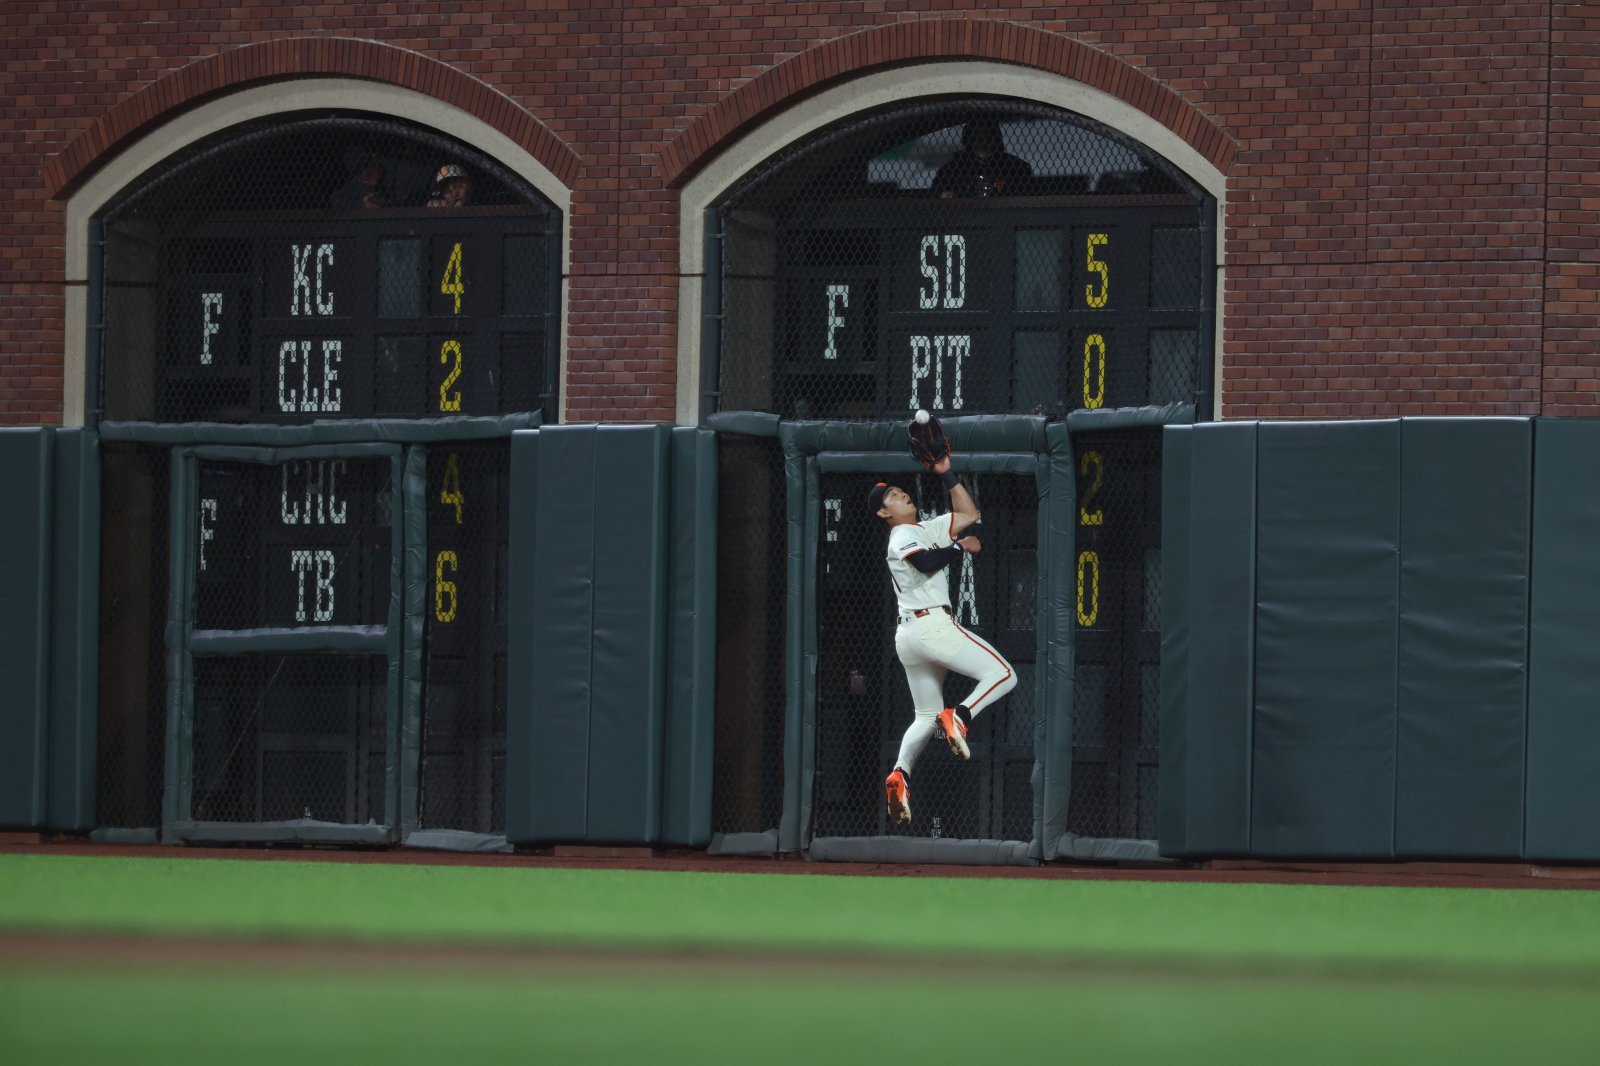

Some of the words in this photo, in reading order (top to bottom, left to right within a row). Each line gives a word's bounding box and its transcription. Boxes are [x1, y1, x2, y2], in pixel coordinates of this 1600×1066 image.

[292, 244, 334, 316] KC
[441, 243, 465, 315] 4
[920, 235, 966, 309] SD
[1086, 234, 1109, 308] 5
[201, 293, 223, 365] F
[825, 285, 849, 360] F
[279, 341, 342, 412] CLE
[440, 341, 461, 412] 2
[910, 336, 970, 410] PIT
[441, 452, 464, 524] 4
[1080, 450, 1103, 526] 2
[292, 551, 335, 622] TB
[436, 551, 458, 623] 6
